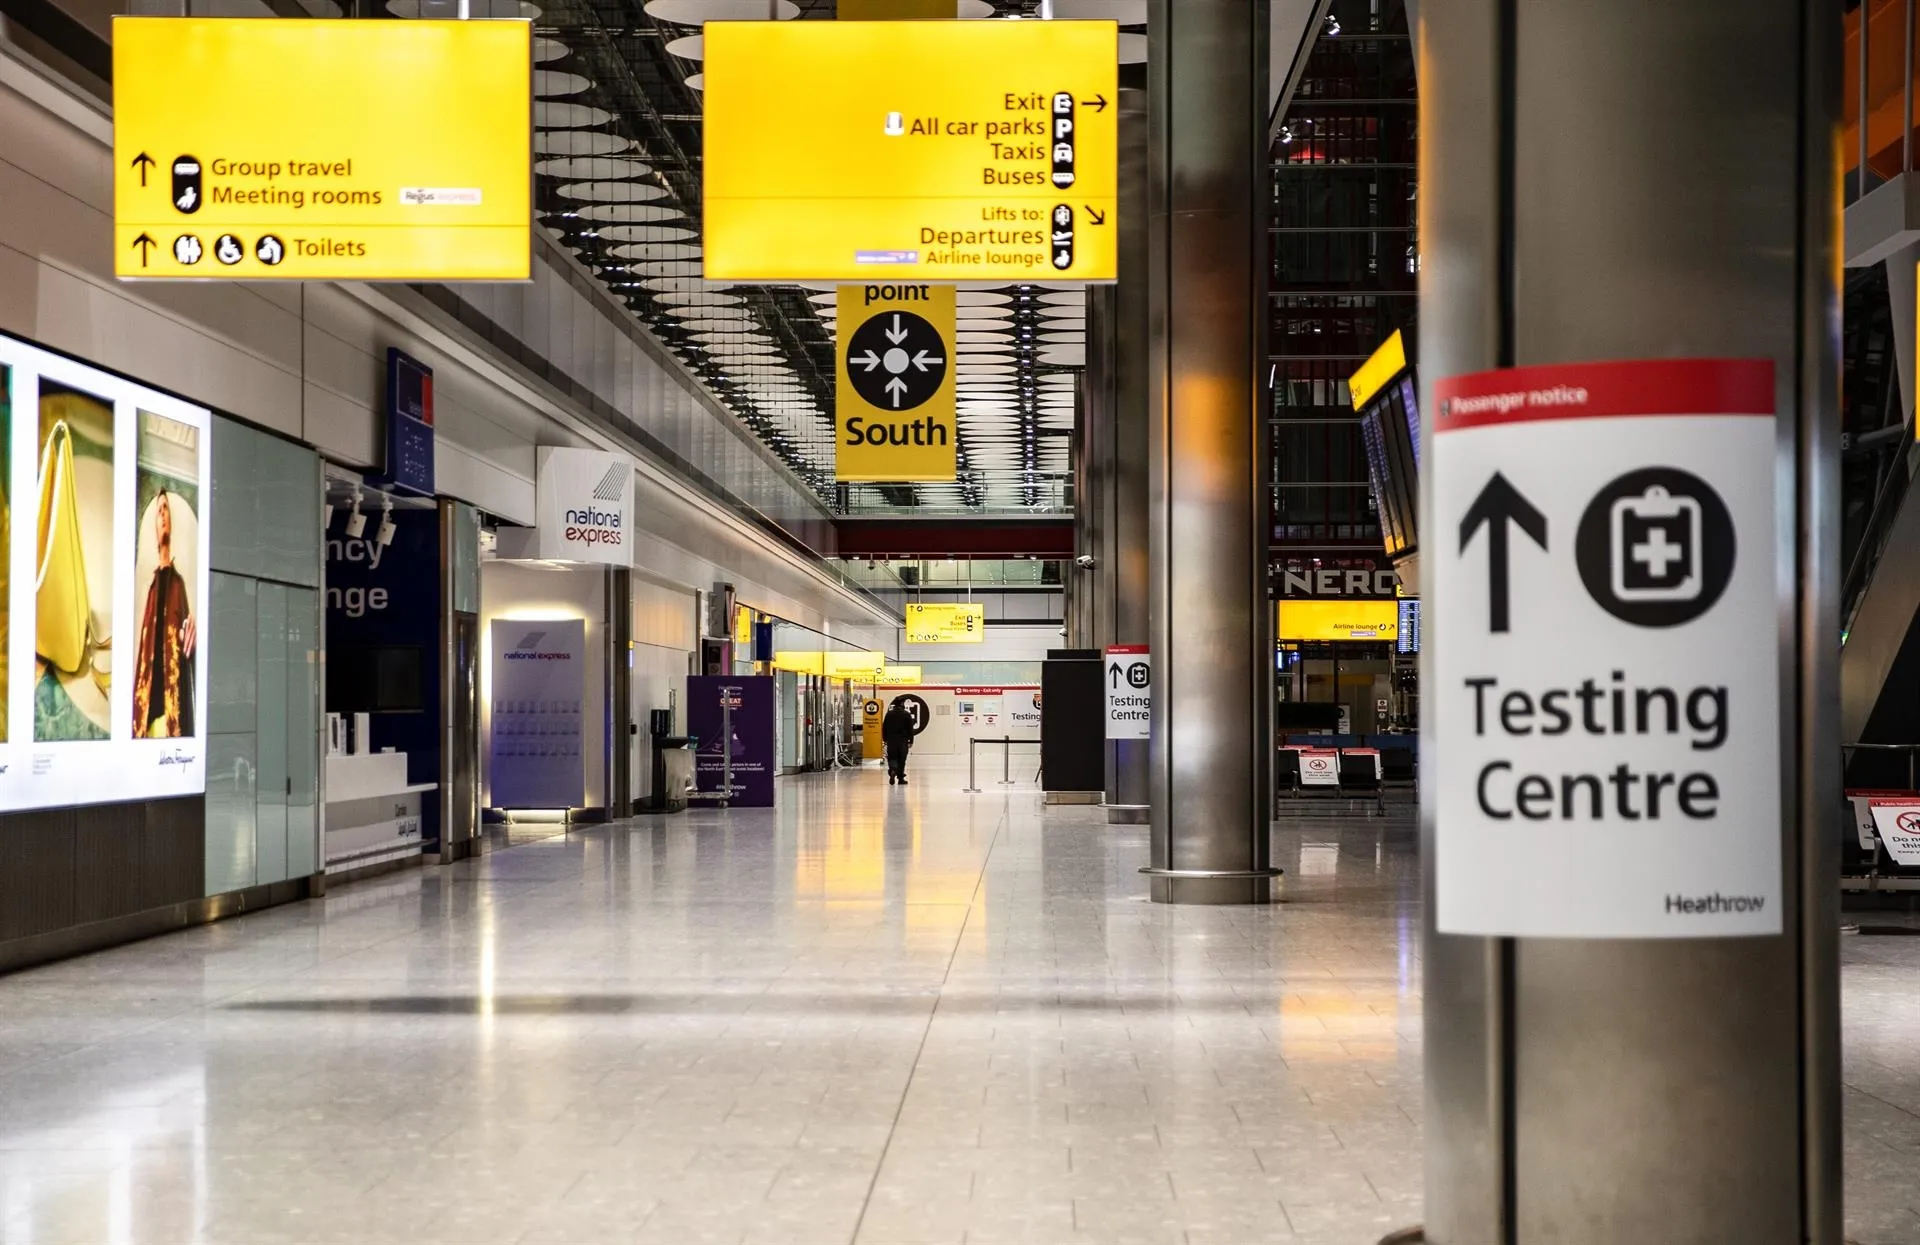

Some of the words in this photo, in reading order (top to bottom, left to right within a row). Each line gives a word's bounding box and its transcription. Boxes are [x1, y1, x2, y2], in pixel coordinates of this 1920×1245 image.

[1004, 92, 1046, 111] Exit
[909, 117, 939, 136] All
[945, 121, 979, 136] car
[985, 117, 1046, 140] parks
[990, 141, 1046, 160] Taxis
[211, 158, 281, 180] Group
[288, 158, 352, 177] travel
[983, 167, 1046, 185] Buses
[212, 186, 305, 209] Meeting
[311, 190, 382, 205] rooms
[981, 207, 1018, 222] Lifts
[1022, 208, 1045, 222] to:
[294, 238, 366, 257] Toilets
[920, 227, 1045, 249] Departures
[925, 250, 981, 265] Airline
[985, 250, 1045, 268] lounge
[864, 284, 930, 306] point
[1451, 390, 1527, 415] Passenger
[1528, 383, 1589, 406] notice
[845, 415, 948, 447] South
[565, 506, 622, 529] national
[565, 526, 622, 547] express
[1284, 569, 1400, 595] NERO
[1355, 623, 1378, 631] lounge
[503, 652, 537, 660] national
[537, 653, 571, 661] express
[1109, 695, 1152, 709] Testing
[1464, 670, 1729, 751] Testing
[1011, 712, 1041, 722] Testing
[1110, 709, 1150, 720] Centre
[1476, 759, 1720, 820] Centre
[1665, 893, 1765, 914] Heathrow
